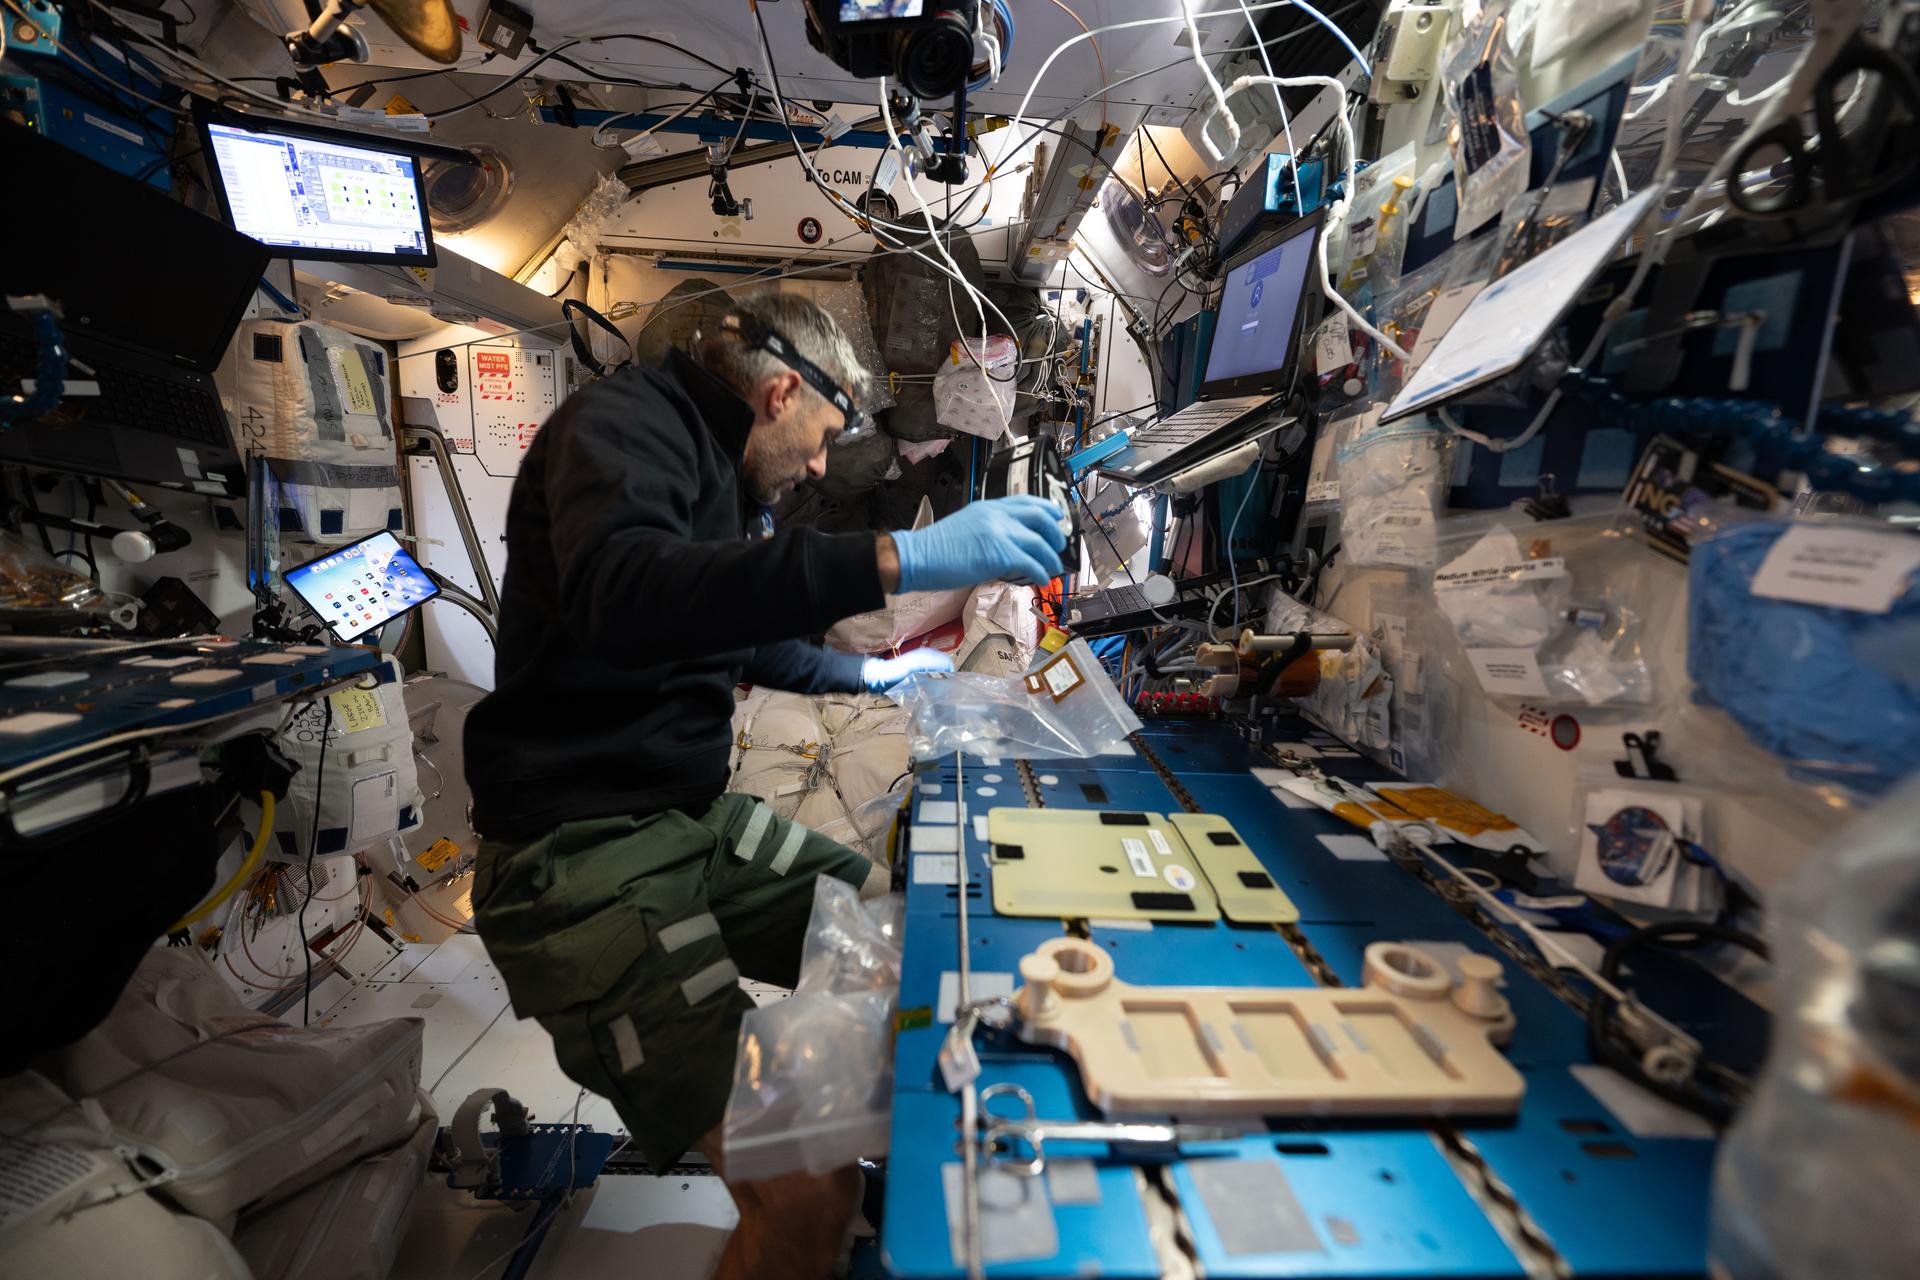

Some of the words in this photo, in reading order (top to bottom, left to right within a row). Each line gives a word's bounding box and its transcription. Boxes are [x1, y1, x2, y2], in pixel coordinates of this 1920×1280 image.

[816, 169, 830, 183] To
[833, 169, 862, 185] CAM
[479, 362, 495, 370] MIST
[496, 363, 509, 371] PFE
[481, 354, 506, 363] WATER
[241, 406, 267, 457] 424
[341, 703, 359, 729] LARGE
